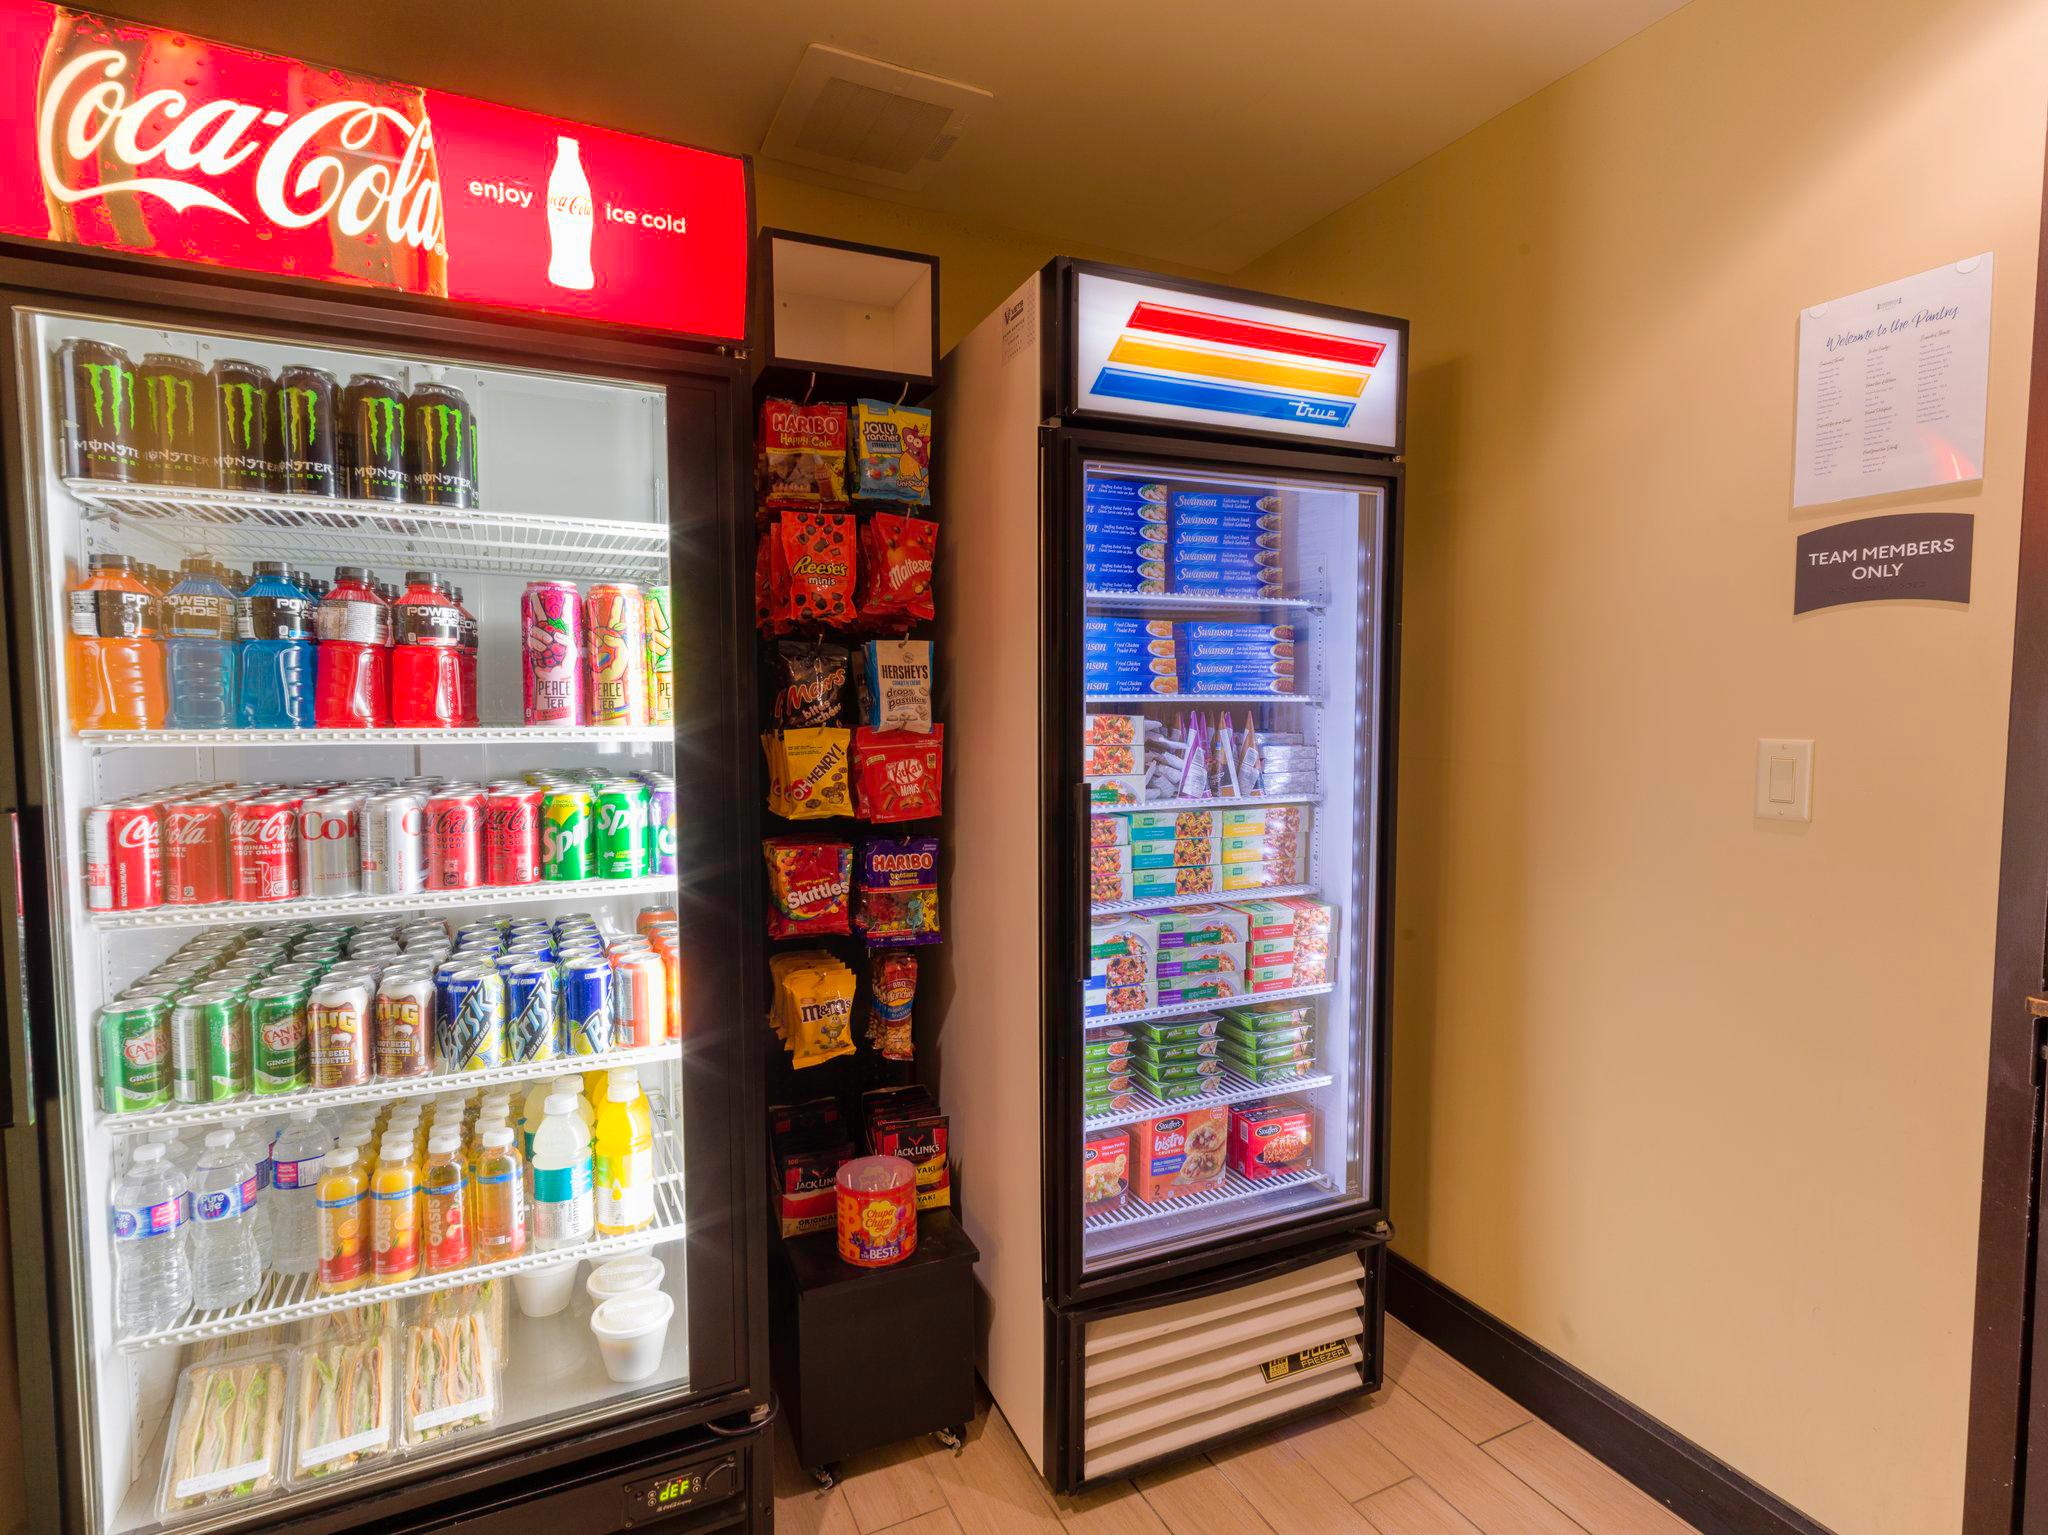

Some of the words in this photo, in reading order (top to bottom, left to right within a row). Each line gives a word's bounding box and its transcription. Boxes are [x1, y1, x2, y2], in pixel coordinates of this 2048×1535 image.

[38, 50, 443, 253] Coca-Cola
[470, 180, 533, 209] enjoy
[606, 203, 637, 225] ice
[641, 212, 687, 234] cold
[1826, 329, 1875, 352] Welcome
[1877, 323, 1888, 336] to
[1890, 318, 1909, 333] the
[1911, 304, 1960, 328] Pantry
[772, 413, 839, 434] HARIBO
[863, 421, 896, 435] JOLLY
[1808, 550, 1858, 566] TEAM
[1862, 538, 1955, 561] MEMBERS
[793, 556, 848, 576] Reese's
[1851, 563, 1904, 580] ONLY
[808, 576, 836, 585] minis
[881, 664, 928, 680] HERSHEY'S
[538, 681, 571, 696] PEACE
[547, 699, 564, 709] TEA
[808, 743, 846, 787] HENRY!
[892, 759, 923, 784] KitKat
[873, 853, 933, 872] HARIBO
[787, 881, 850, 910] Skittles
[509, 986, 549, 1063] BRIS
[894, 1147, 914, 1157] JACK
[1154, 1133, 1185, 1153] bistro
[794, 1179, 818, 1191] JACK
[1154, 1184, 1161, 1197] 2
[429, 1198, 442, 1247] OASIS
[865, 1217, 894, 1229] Chups
[866, 1208, 894, 1219] Chupa
[377, 1204, 392, 1254] OASIS
[870, 1248, 893, 1260] BEST
[1301, 1348, 1346, 1368] FREEZER
